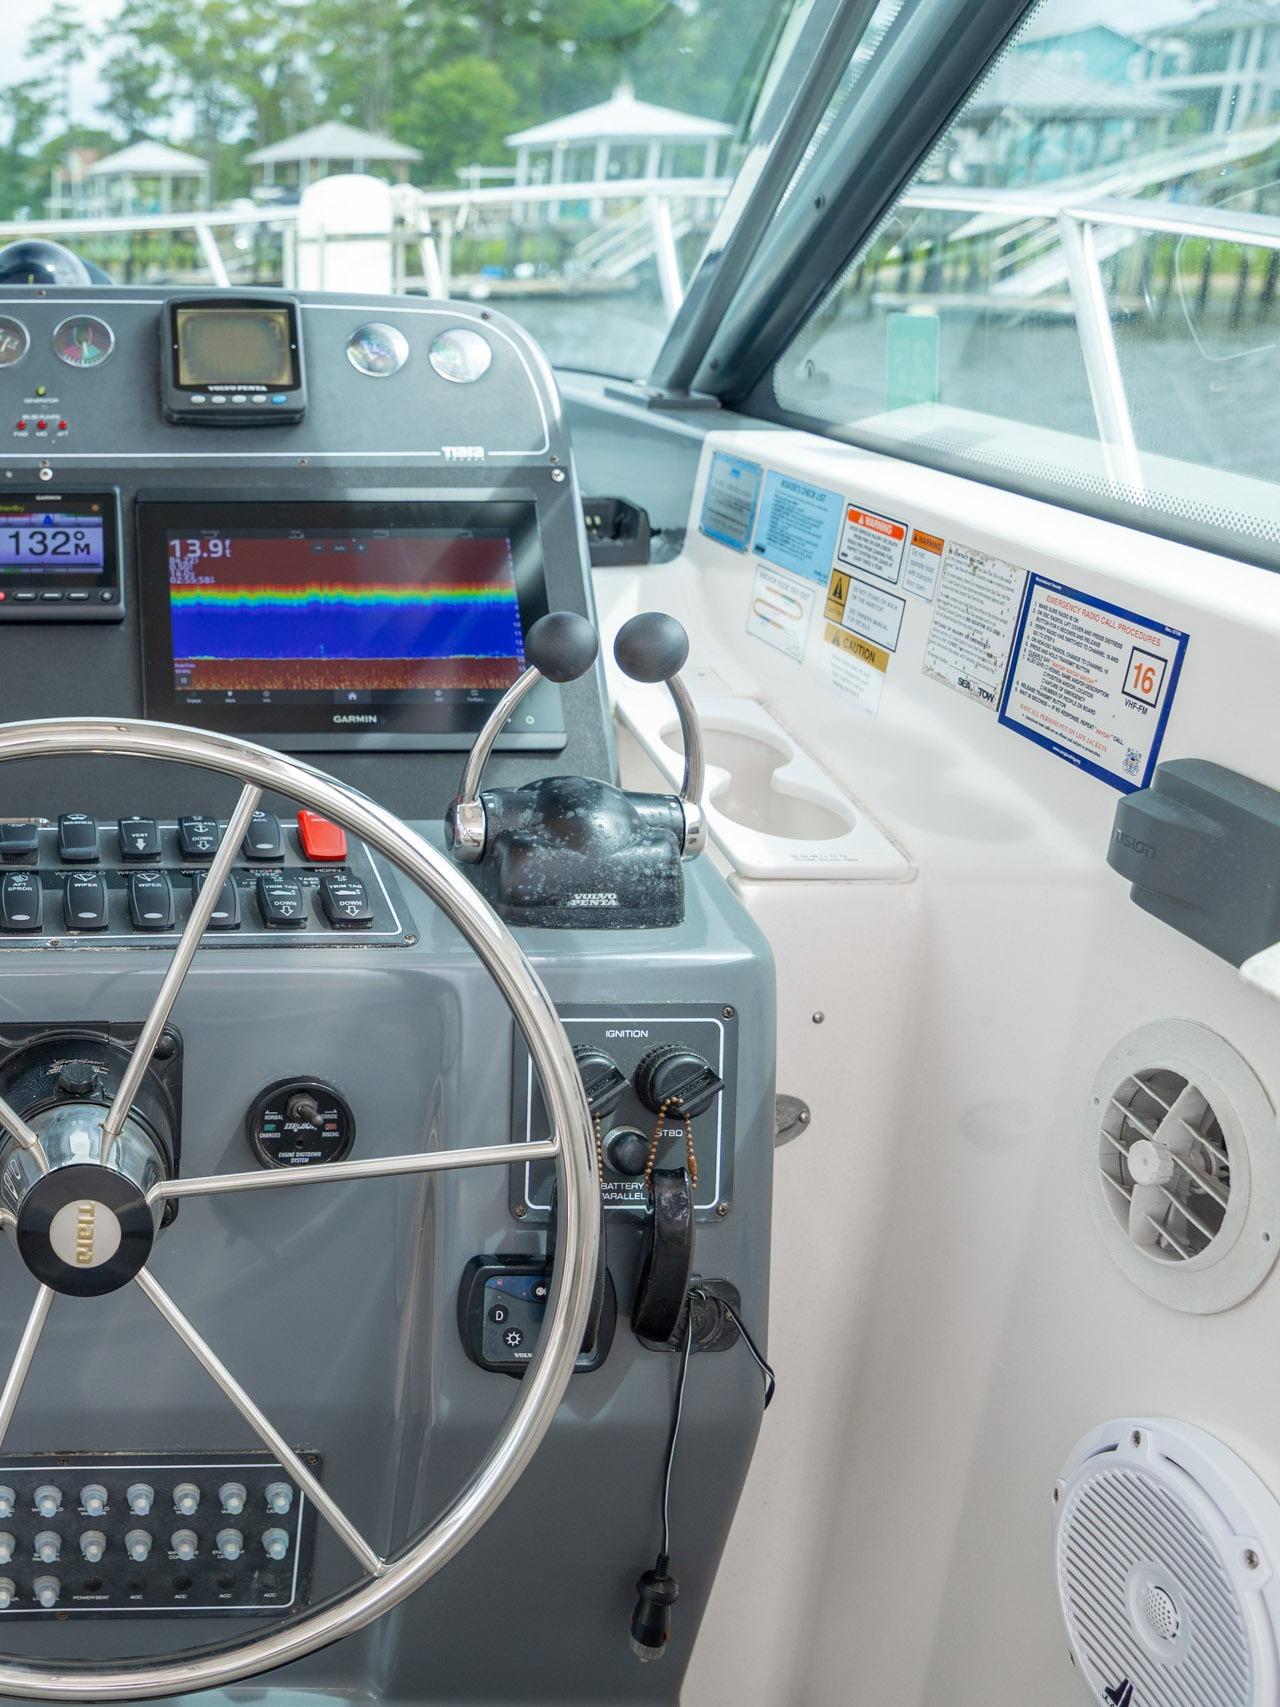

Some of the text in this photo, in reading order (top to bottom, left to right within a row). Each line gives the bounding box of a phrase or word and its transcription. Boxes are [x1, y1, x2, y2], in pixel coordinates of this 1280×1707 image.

[169, 539, 224, 558] 13.9
[1046, 593, 1081, 615] EMERGENCY
[1081, 608, 1100, 622] RADIO
[1100, 615, 1117, 629] CALL
[1117, 622, 1161, 647] PROCEDURES
[842, 636, 875, 663] CAUTION
[1131, 662, 1156, 695] 16
[957, 677, 994, 702] SEA TOW
[1124, 698, 1147, 715] VHF-FM
[333, 715, 377, 723] GARMIN
[605, 1030, 648, 1038] IGNITION
[657, 1129, 683, 1137] STBD
[496, 1310, 504, 1321] D
